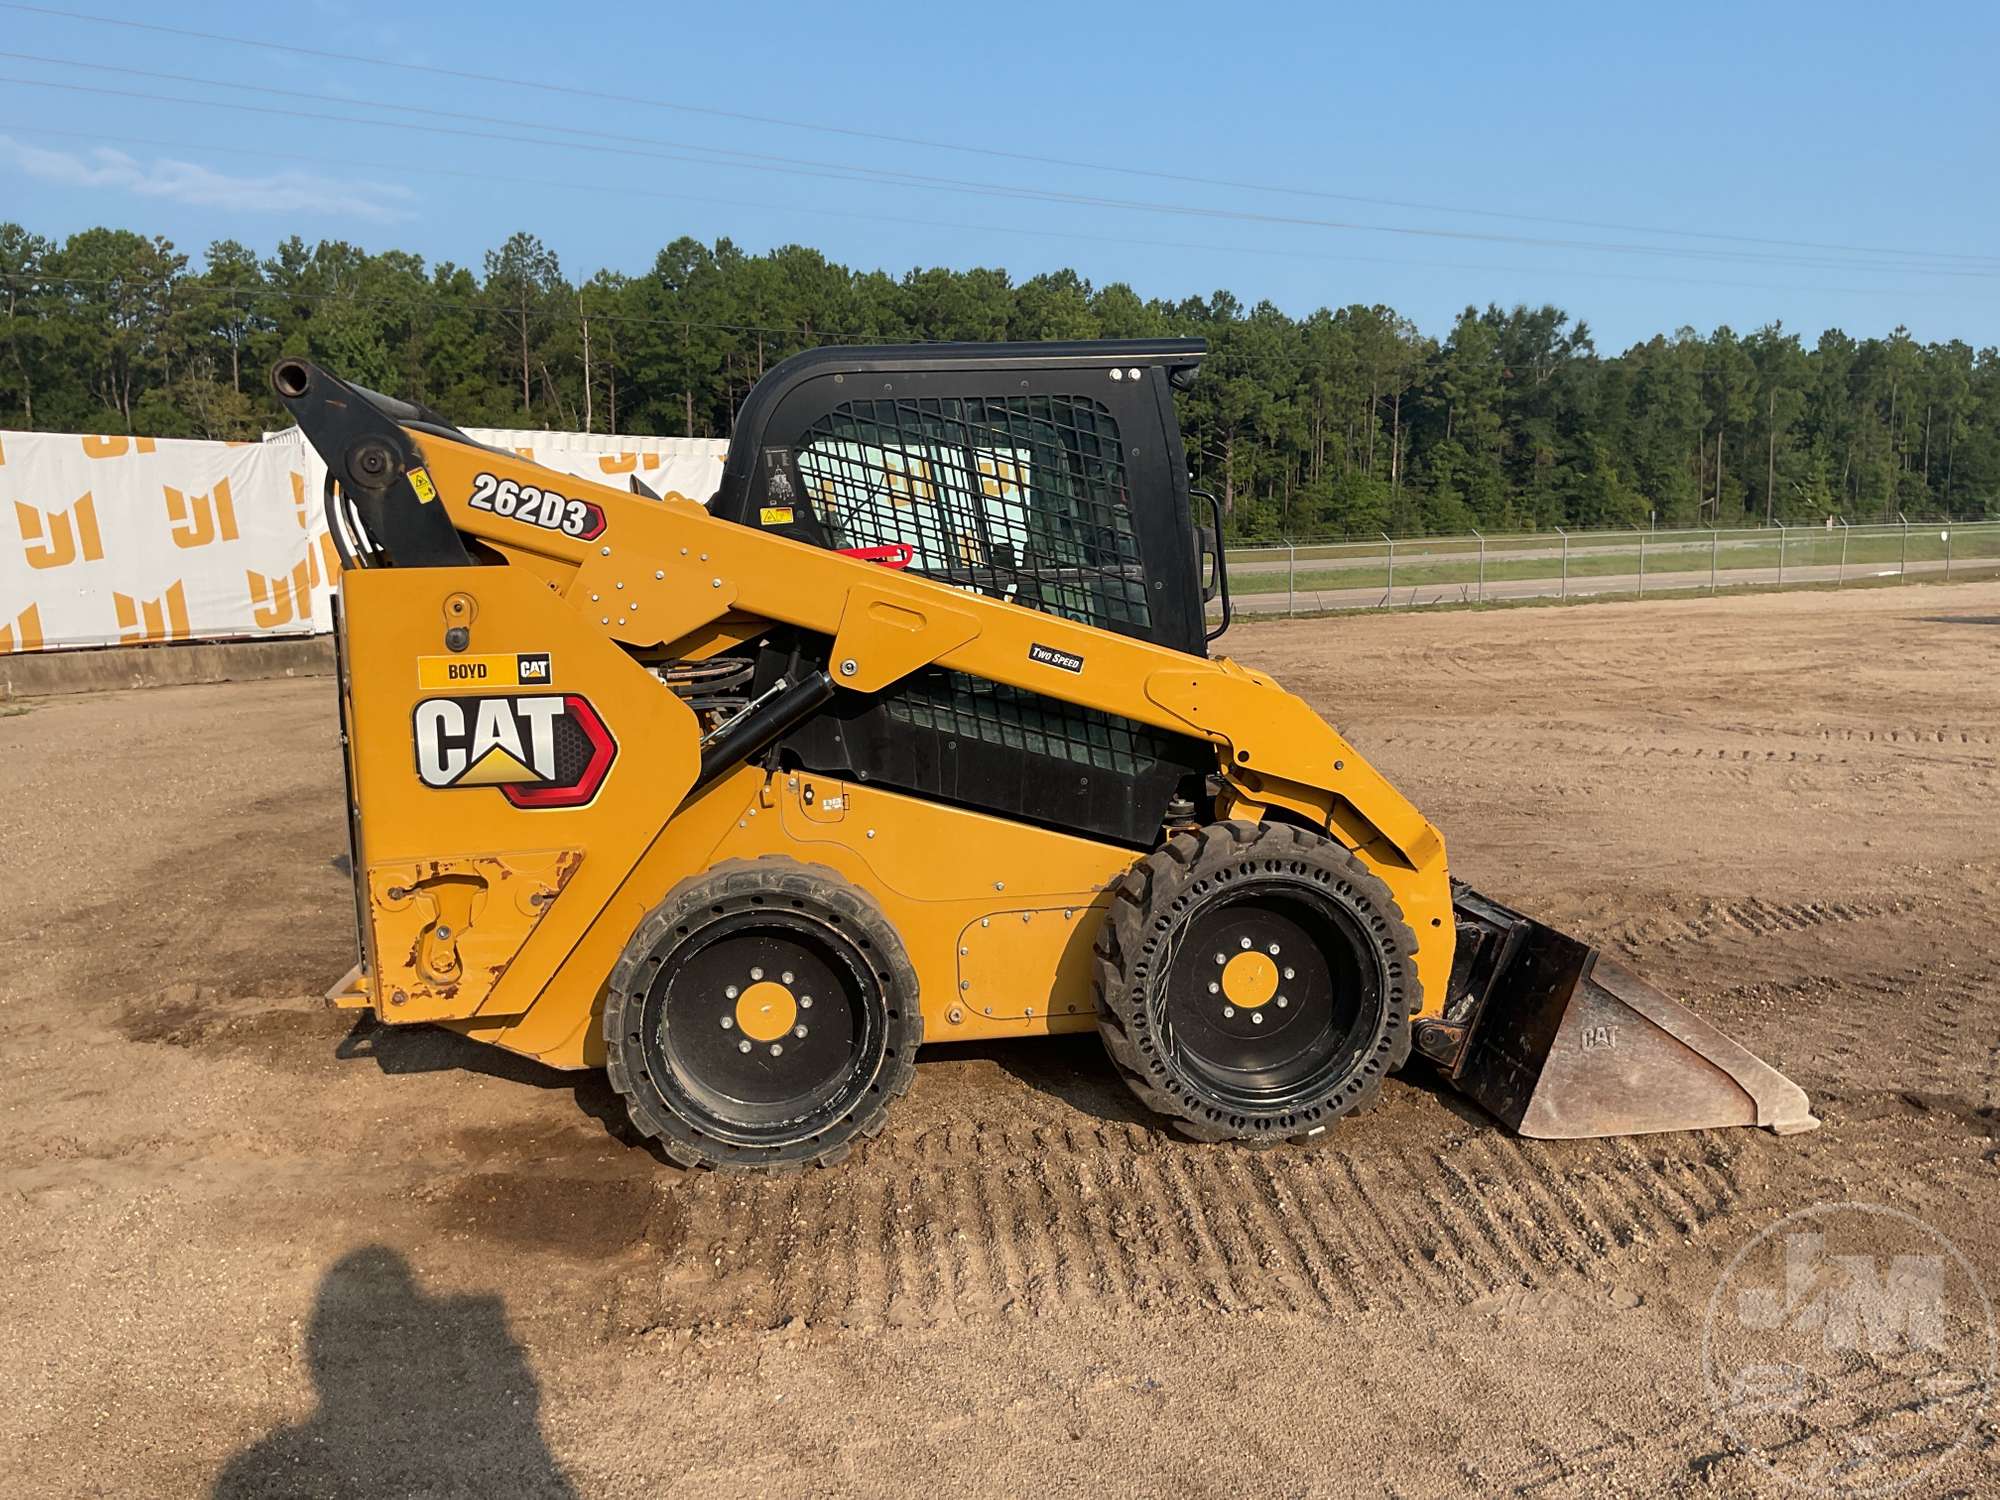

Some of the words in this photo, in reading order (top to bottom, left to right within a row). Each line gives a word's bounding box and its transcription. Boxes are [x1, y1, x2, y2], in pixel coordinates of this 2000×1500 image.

[468, 473, 588, 536] 262D3
[448, 663, 487, 680] BOYD
[519, 660, 548, 678] CAT
[415, 696, 565, 786] CAT
[1580, 1025, 1619, 1051] CAT
